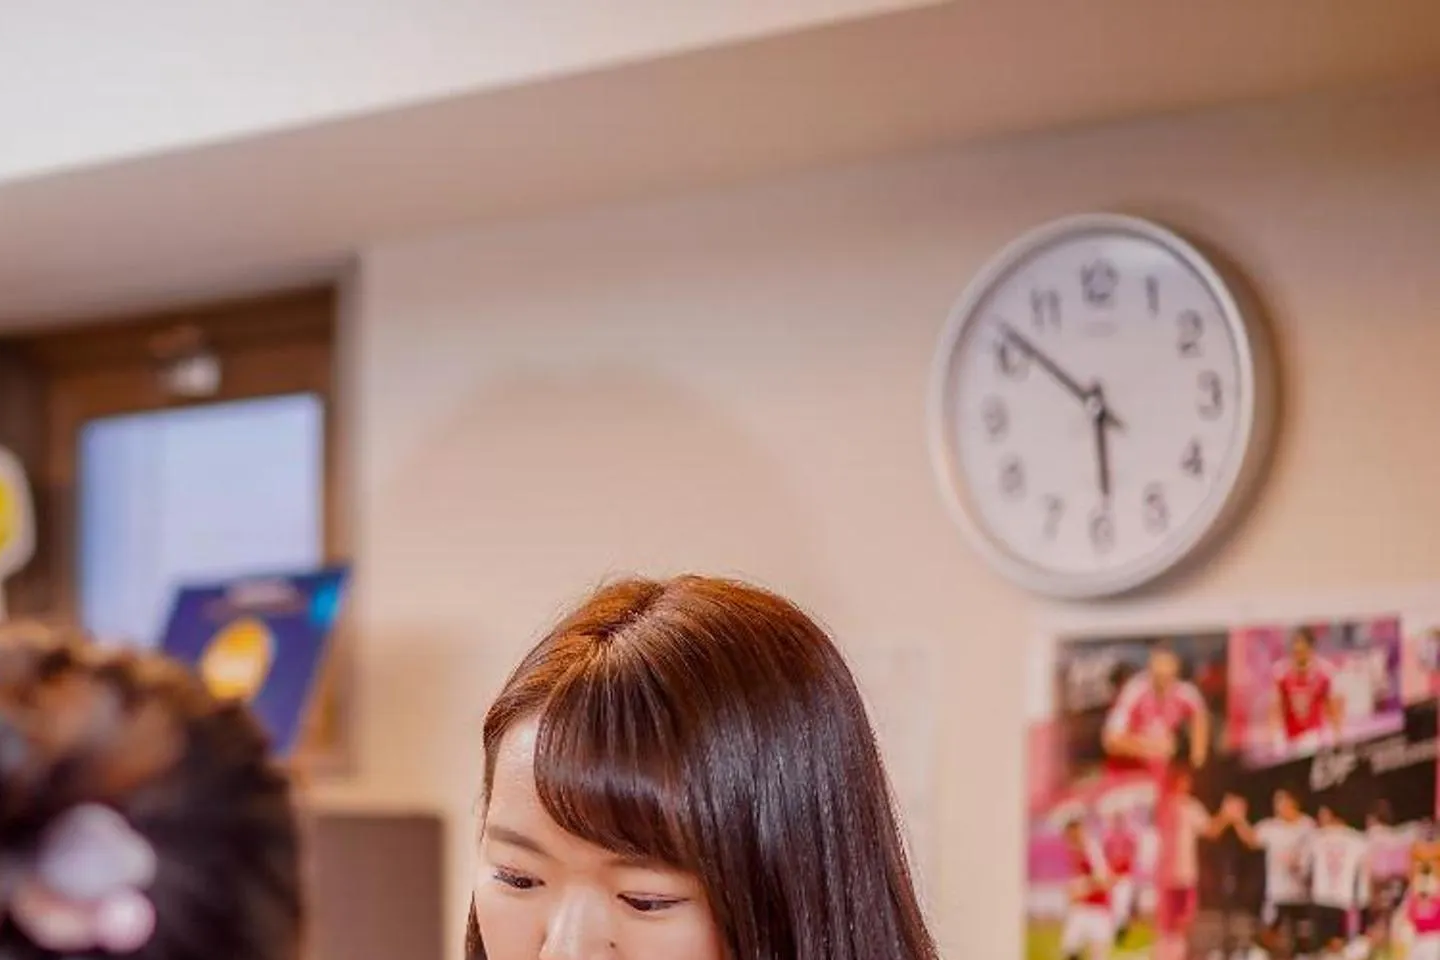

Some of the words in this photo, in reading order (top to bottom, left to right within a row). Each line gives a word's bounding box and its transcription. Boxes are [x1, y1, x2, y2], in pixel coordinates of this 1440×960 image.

[1080, 259, 1119, 306] 12
[1145, 275, 1160, 319] 1
[1030, 287, 1061, 333] 11
[1176, 308, 1205, 357] 2
[982, 394, 1010, 441] 9
[1197, 370, 1224, 422] 3
[1000, 455, 1027, 497] 8
[1180, 438, 1205, 477] 4
[1043, 494, 1066, 539] 7
[1089, 508, 1115, 553] 6
[1142, 482, 1169, 534] 5
